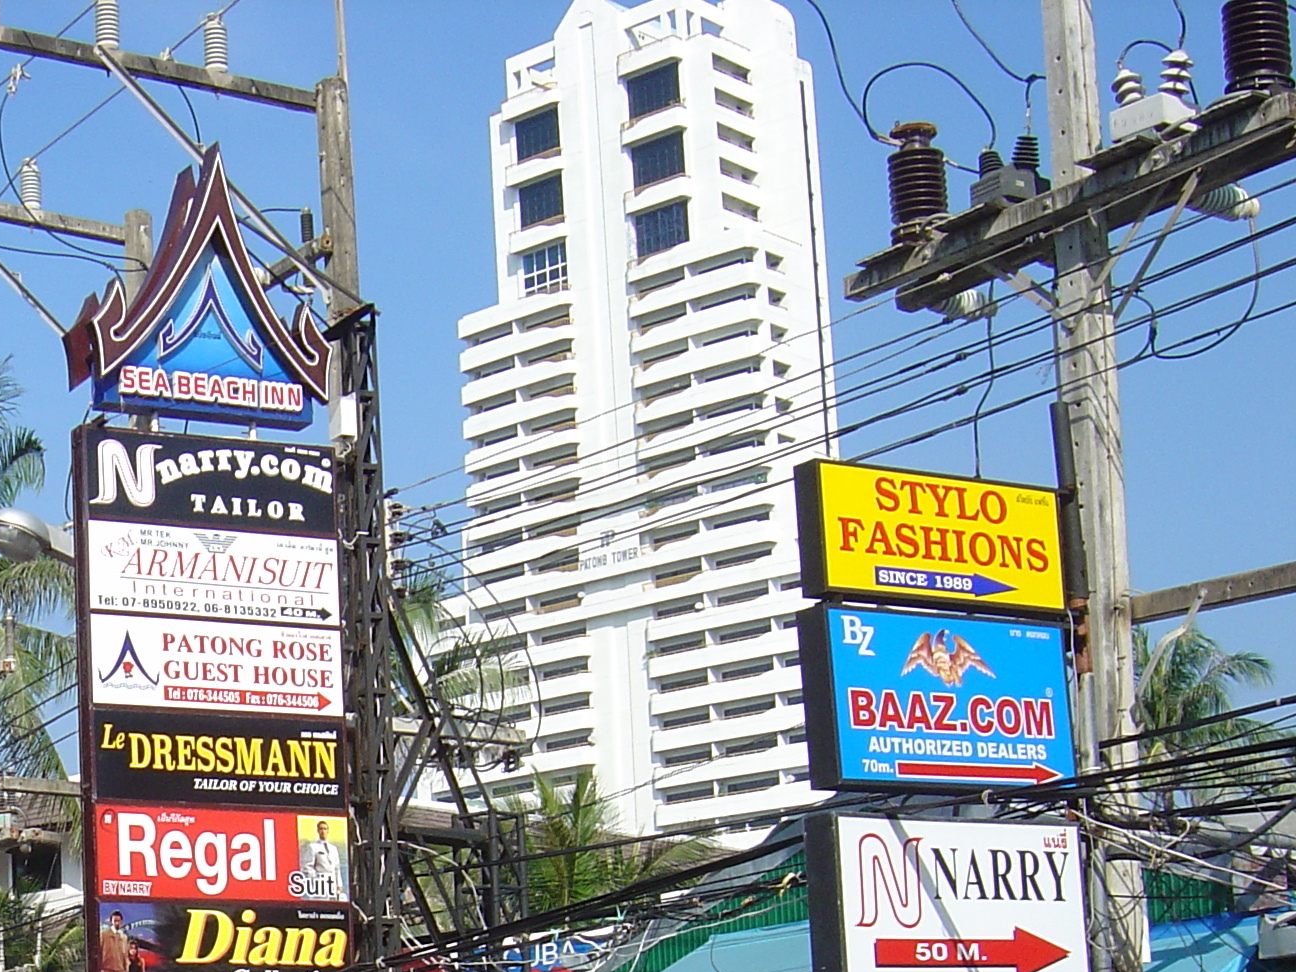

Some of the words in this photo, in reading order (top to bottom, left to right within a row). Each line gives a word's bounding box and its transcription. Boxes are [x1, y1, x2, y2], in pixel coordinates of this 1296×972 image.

[120, 366, 172, 397] SEA
[175, 371, 257, 405] BEACH
[261, 381, 304, 411] INN
[191, 494, 305, 522] TAILOR
[874, 476, 1007, 525] STYLO
[837, 516, 1049, 573] FASHIONS
[579, 554, 607, 572] PATONG
[611, 546, 639, 564] TOWER
[132, 581, 315, 607] International
[878, 570, 929, 587] SINCE
[934, 574, 973, 591] 1989
[282, 608, 304, 617] 40
[161, 632, 263, 658] PATONG
[272, 640, 334, 662] ROSE
[163, 660, 244, 683] GUEST
[253, 665, 334, 689] HOUSE
[848, 687, 1055, 739] BAAZ.COM
[101, 723, 125, 750] Le
[128, 732, 338, 780] DRESSMANN
[868, 736, 974, 759] AUTHORIZED
[977, 741, 1047, 761] DEALERS
[862, 758, 894, 775] 70m.
[193, 777, 238, 792] TAILOR
[239, 779, 257, 792] OF
[257, 781, 292, 794] YOUR
[293, 782, 339, 796] CHOICE
[117, 812, 277, 896] Regal
[104, 881, 117, 893] BY
[119, 882, 150, 895] NARRY
[289, 872, 336, 898] Suit
[930, 847, 1069, 903] NARRY
[175, 909, 348, 968] Diana
[914, 943, 949, 961] 50
[956, 943, 988, 962] M.
